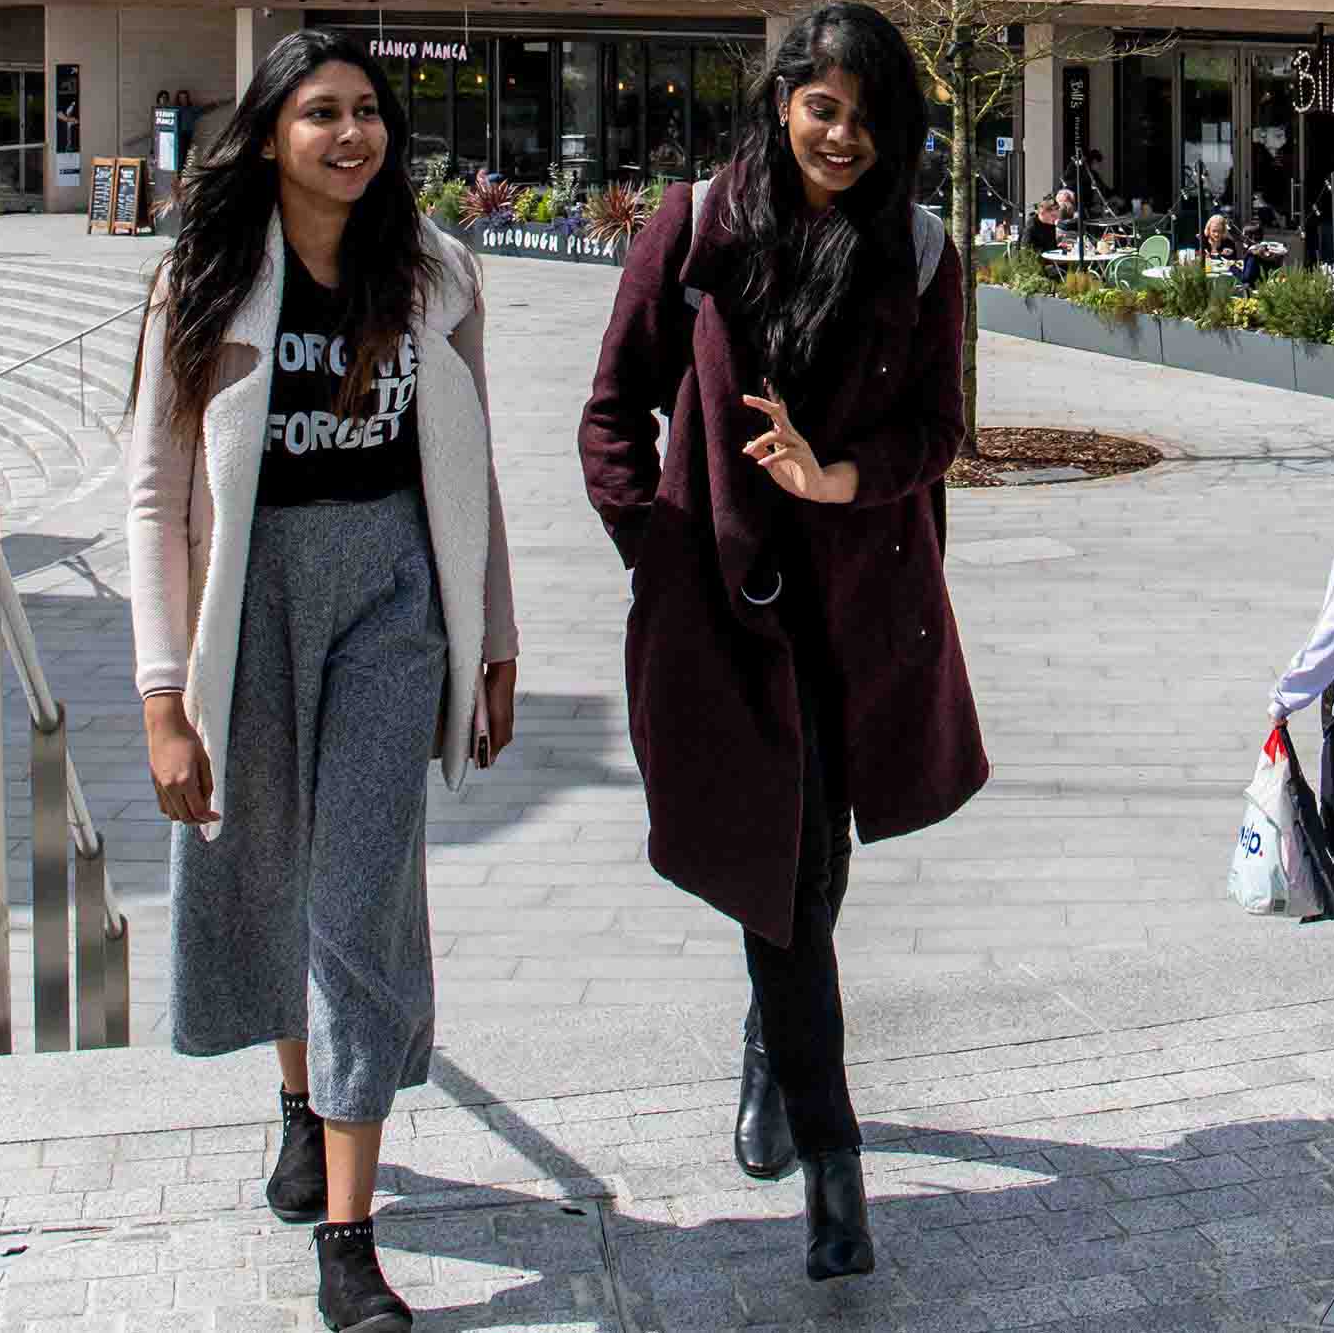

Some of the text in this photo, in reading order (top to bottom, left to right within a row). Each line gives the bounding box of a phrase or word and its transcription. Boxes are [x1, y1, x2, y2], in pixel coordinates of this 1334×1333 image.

[369, 39, 468, 62] FRANCO MANCA
[482, 227, 617, 259] SOURDOUGH PIZZA
[371, 373, 417, 415] TO
[266, 410, 400, 456] FORGET
